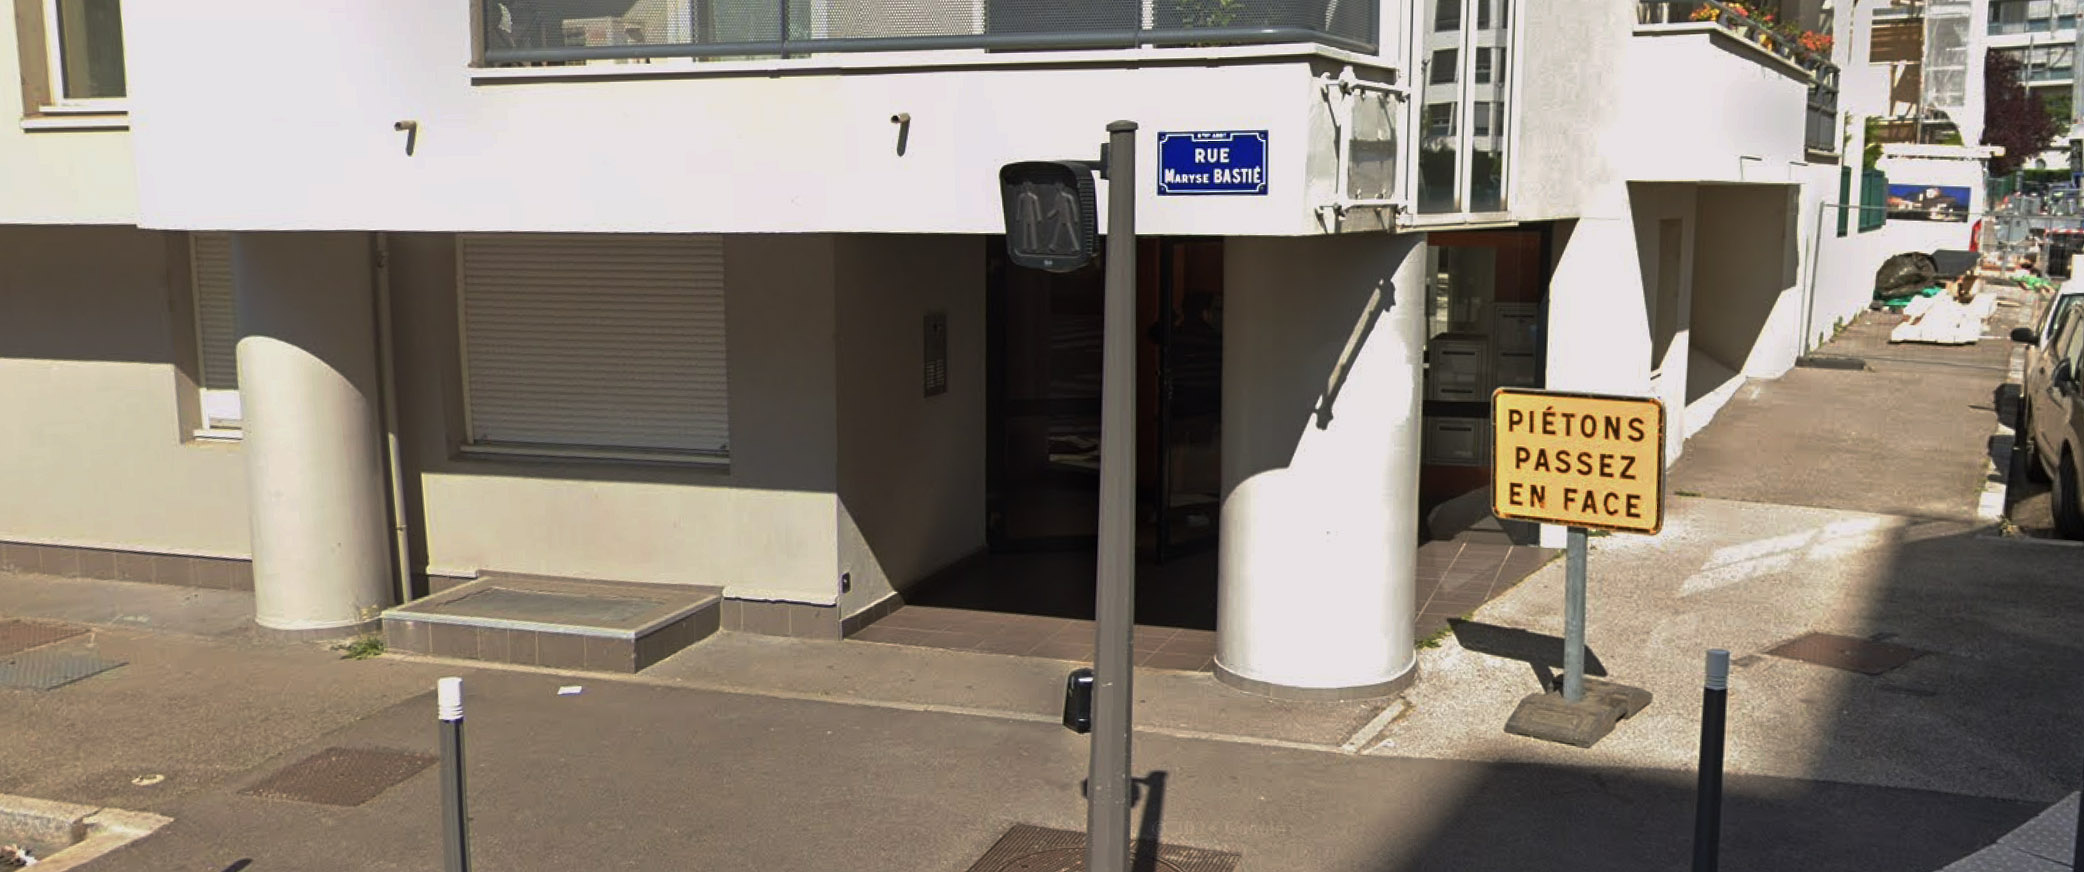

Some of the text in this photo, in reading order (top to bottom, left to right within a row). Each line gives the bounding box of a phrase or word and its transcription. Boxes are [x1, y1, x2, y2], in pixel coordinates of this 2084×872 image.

[1195, 148, 1230, 163] RUE
[1213, 166, 1261, 183] BASTIÉ
[1508, 405, 1645, 442] PIÉTONS
[1515, 446, 1637, 480] PASSEZ
[1509, 482, 1642, 519] EN FACE
